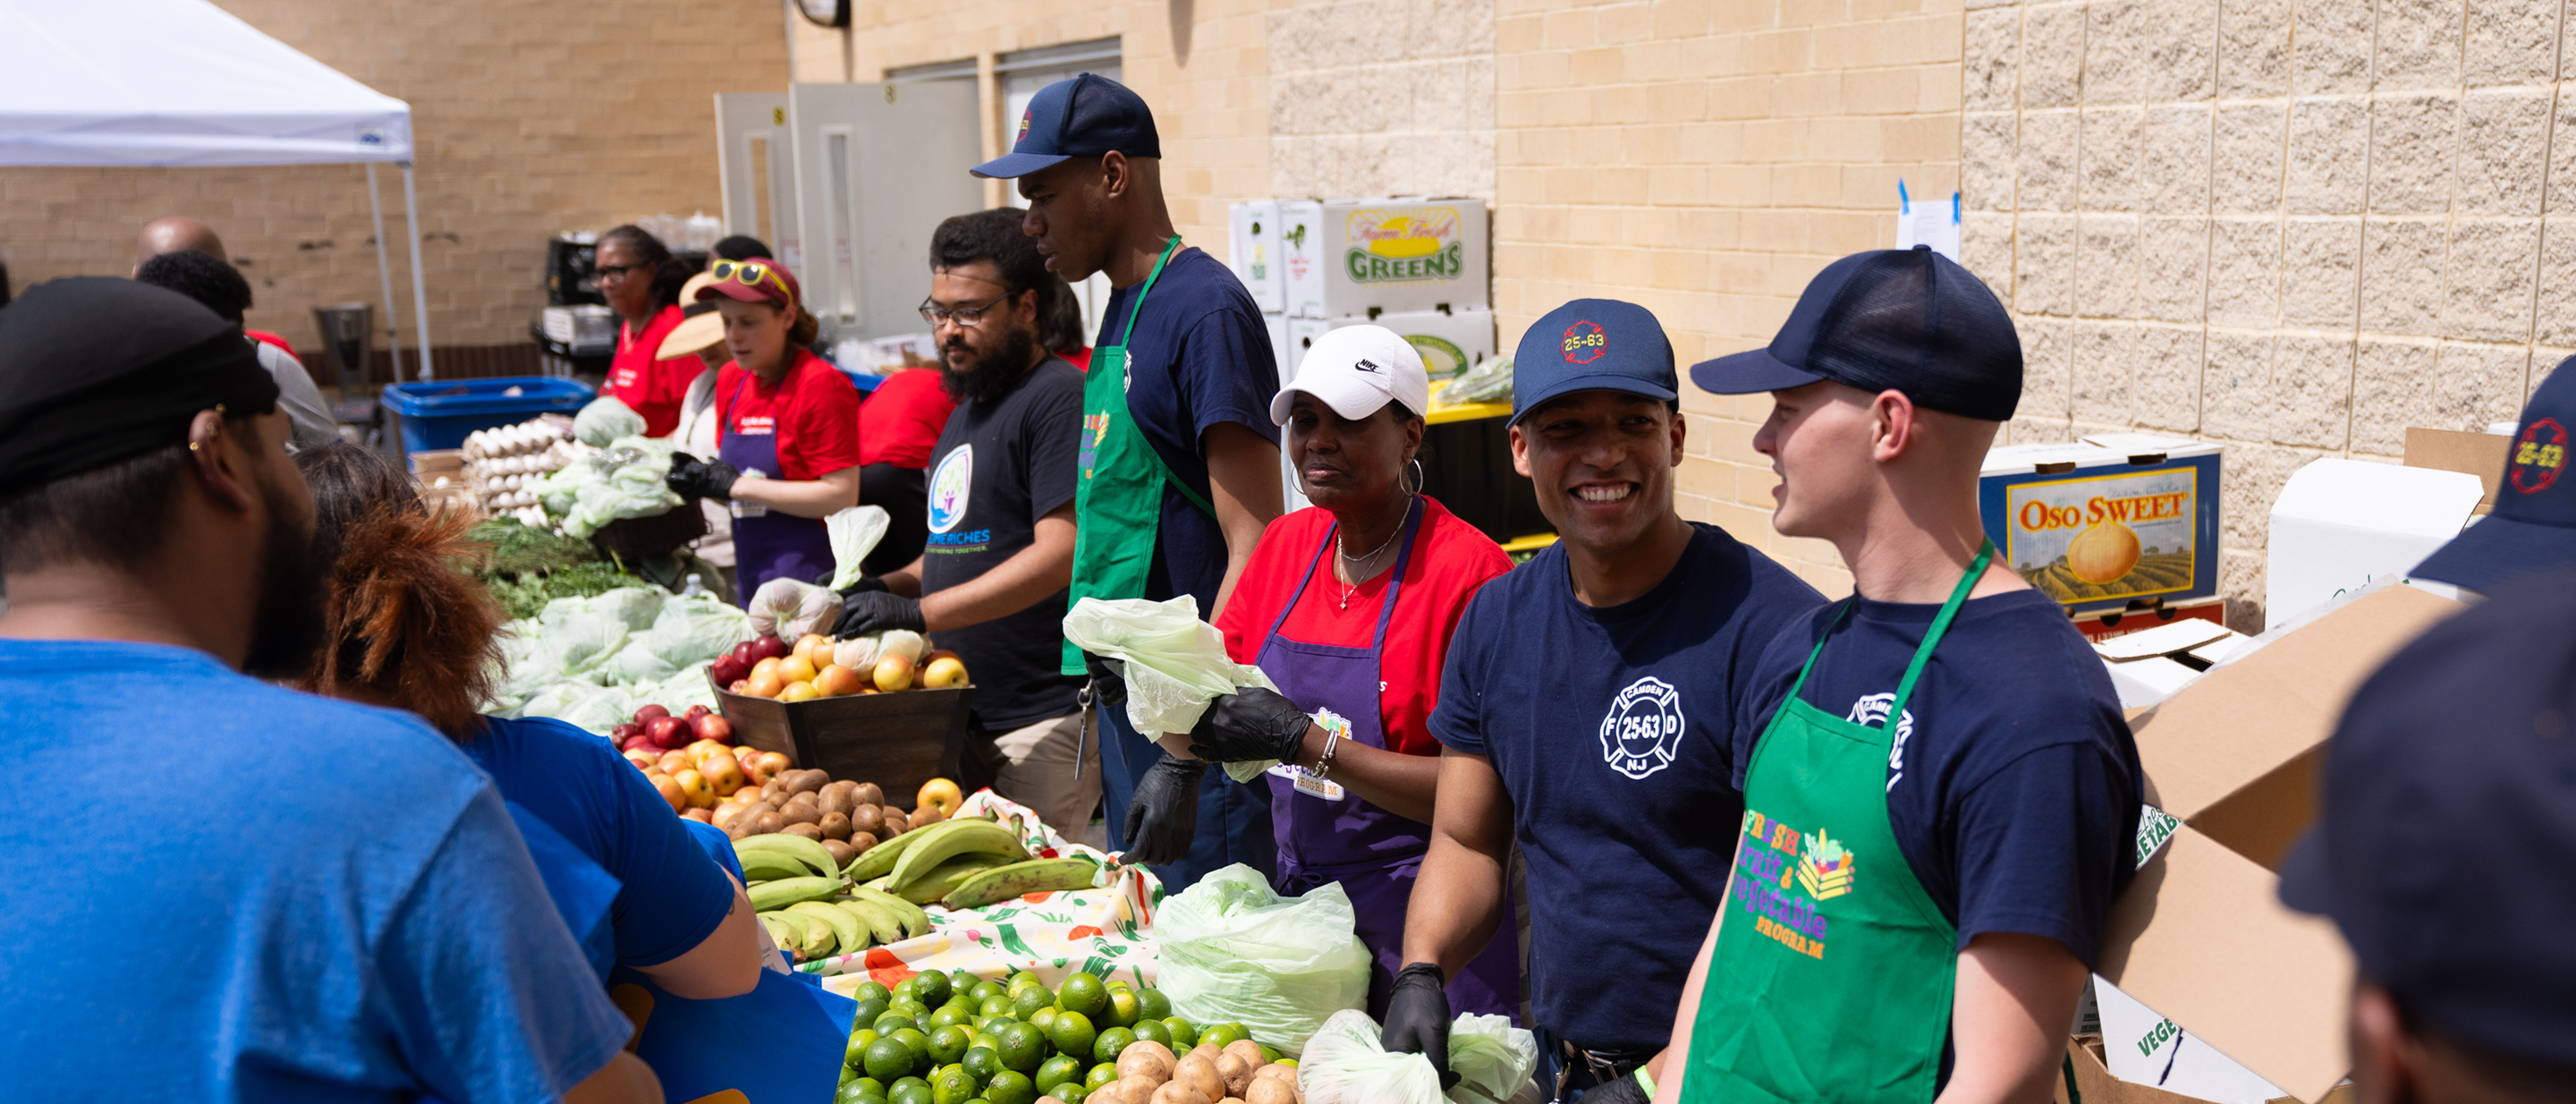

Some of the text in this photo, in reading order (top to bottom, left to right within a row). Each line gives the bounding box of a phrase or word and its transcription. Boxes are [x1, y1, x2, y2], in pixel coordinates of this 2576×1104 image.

[1352, 217, 1456, 242] Farm Fresh
[1347, 241, 1462, 283] GREENS
[1564, 334, 1604, 351] 25-63
[1360, 358, 1378, 372] NIKE
[947, 529, 990, 545] RICHES
[1626, 684, 1664, 699] CAMDEN
[1606, 715, 1677, 740] F 25-63 D
[1627, 759, 1647, 770] NJ
[1297, 776, 1338, 796] PROGRAM
[1744, 809, 1801, 856] FRESH
[1780, 866, 1793, 889] &
[1755, 915, 1826, 960] PROGRAM
